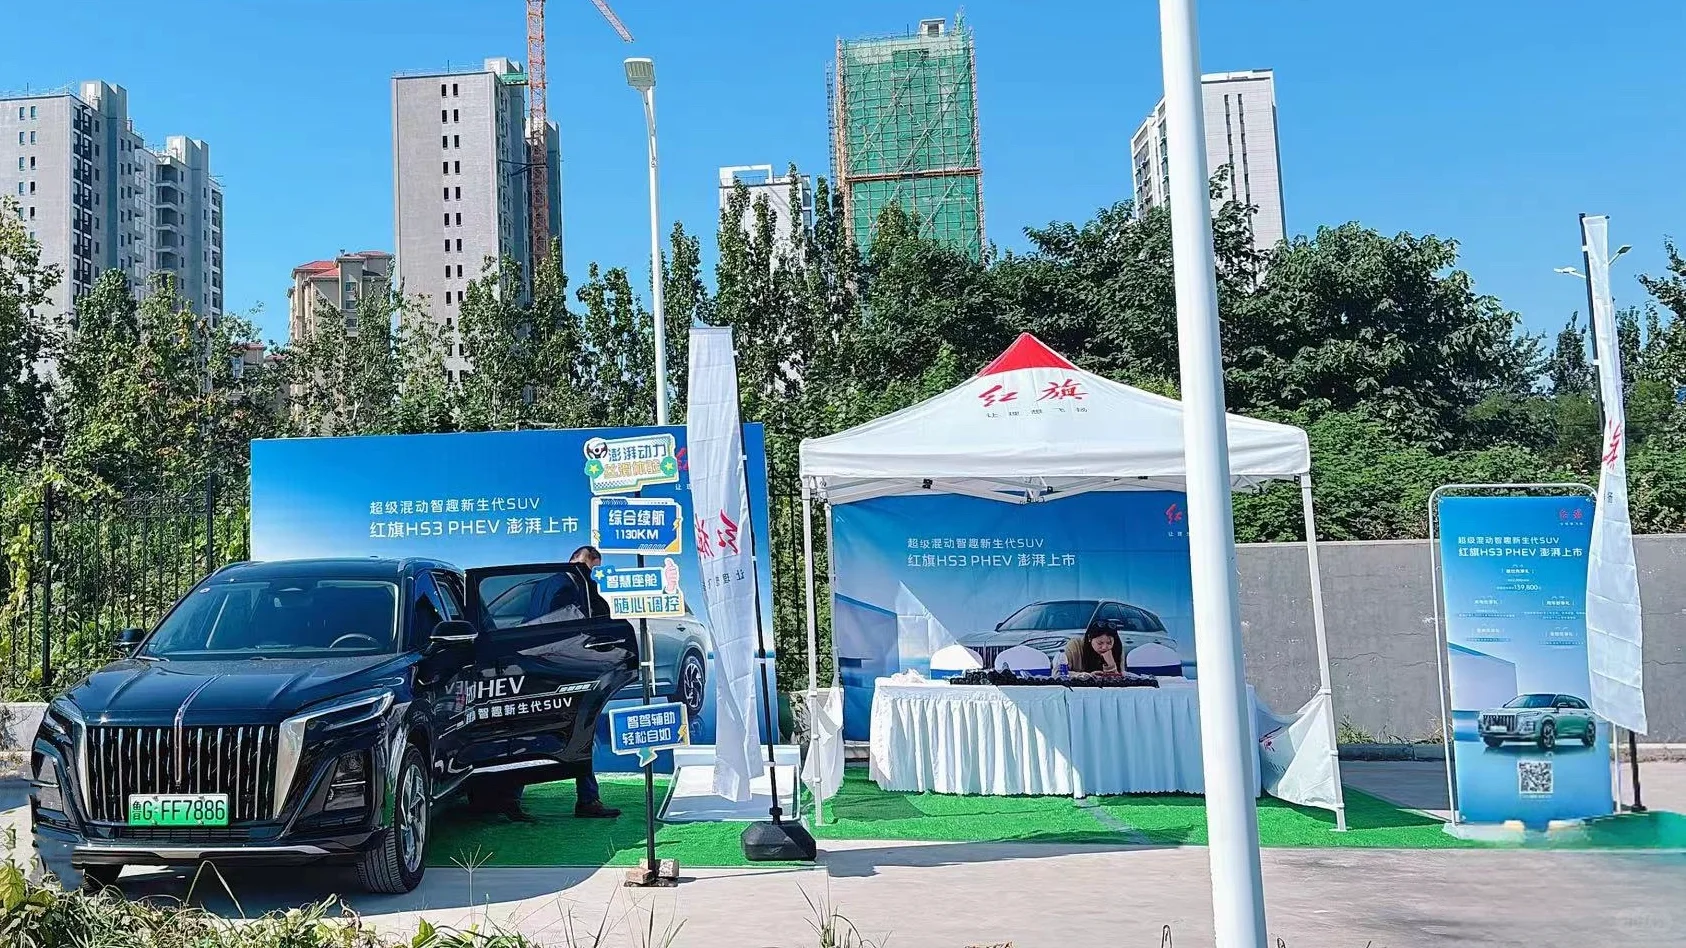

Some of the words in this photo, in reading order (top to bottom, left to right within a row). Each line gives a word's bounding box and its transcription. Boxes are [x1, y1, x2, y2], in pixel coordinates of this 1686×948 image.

[979, 379, 1088, 407] 红旗
[609, 444, 667, 461] 澎湃动力
[370, 498, 540, 515] 超级混动智趣新生代SUV
[608, 509, 665, 526] 综合续航
[370, 519, 443, 538] 红旗HS3
[449, 520, 500, 535] PHEV
[507, 516, 579, 535] 澎湃上市
[615, 529, 659, 540] 1130KM
[907, 538, 1044, 549] 超级混动智趣新生代SUV
[907, 554, 967, 567] 红旗HS3
[971, 555, 1012, 567] PHEV
[1017, 553, 1076, 567] 澎湃上市
[1505, 548, 1537, 557] PHEV
[606, 574, 658, 589] 智慧座舱
[613, 595, 680, 614] 随心调控
[626, 711, 676, 729] 智驾辅助
[621, 727, 672, 746] 轻松自如
